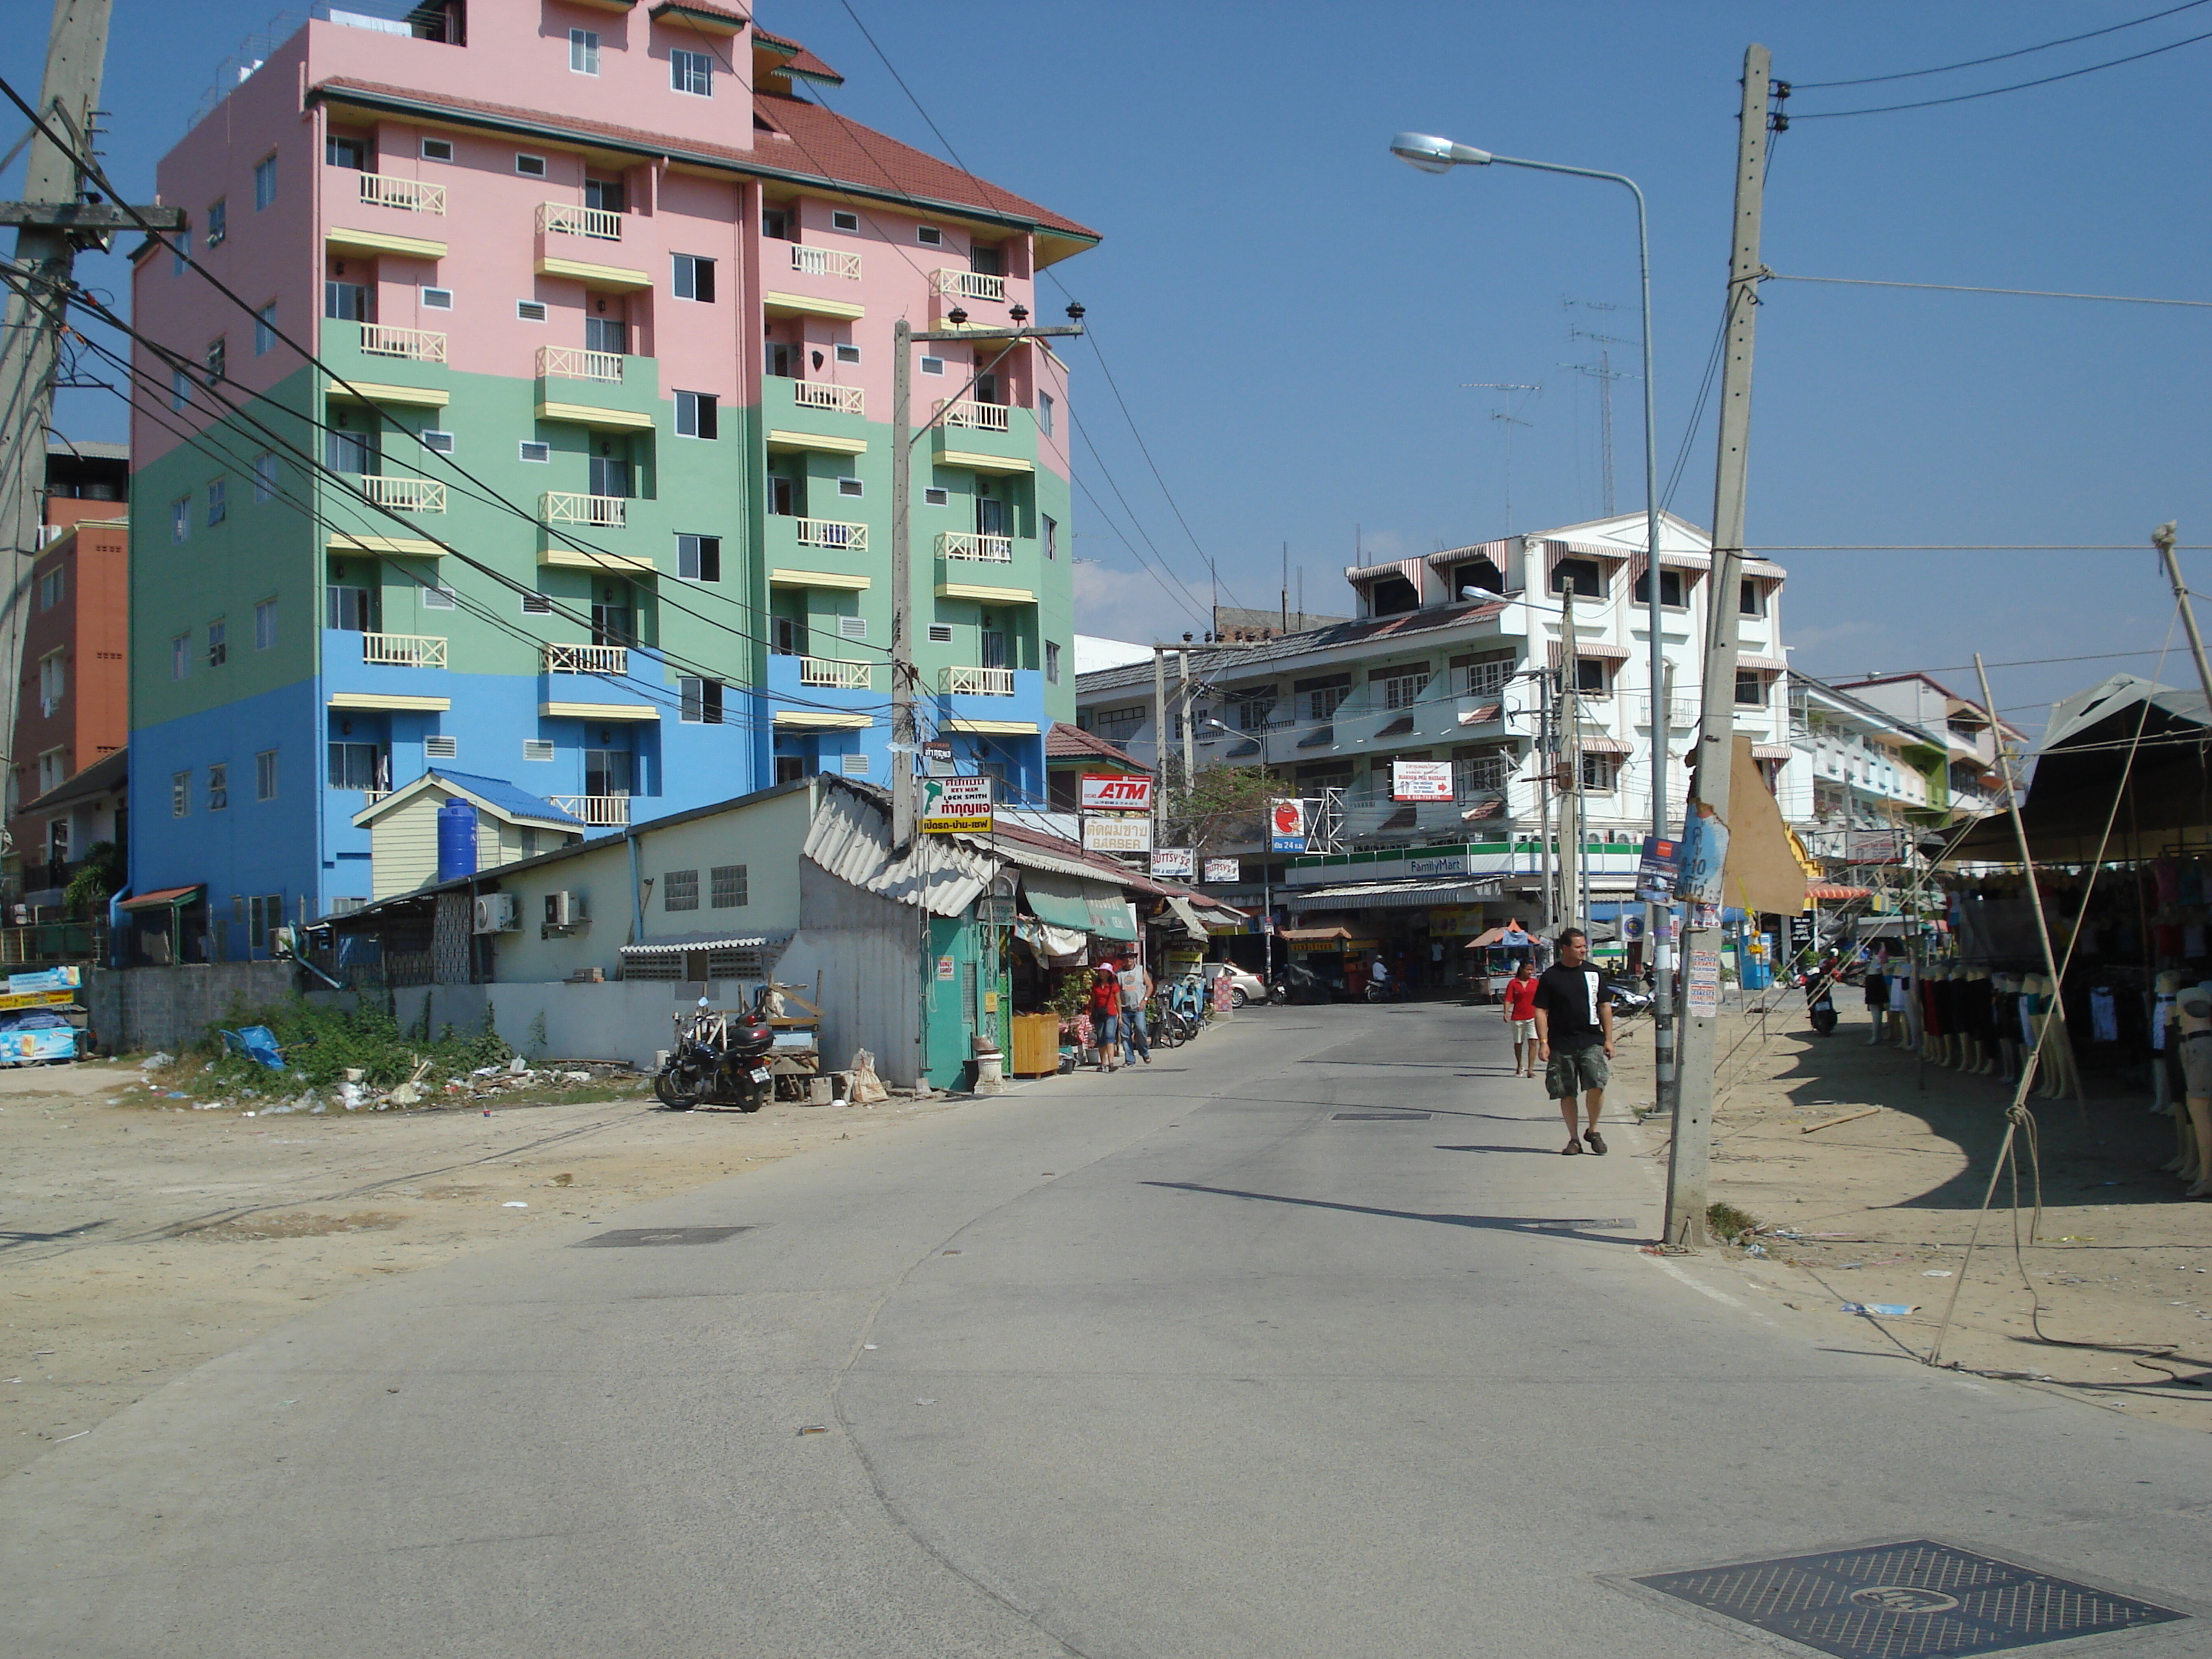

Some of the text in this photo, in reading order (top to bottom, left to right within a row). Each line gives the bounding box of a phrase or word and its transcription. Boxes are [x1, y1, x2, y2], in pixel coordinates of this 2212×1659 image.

[1097, 783, 1148, 800] ATM
[941, 800, 990, 817] ทำกุญแจ
[1092, 839, 1141, 850] BARBER
[1152, 853, 1185, 865] BUTTSY'S
[1411, 858, 1462, 873] FamilyMart
